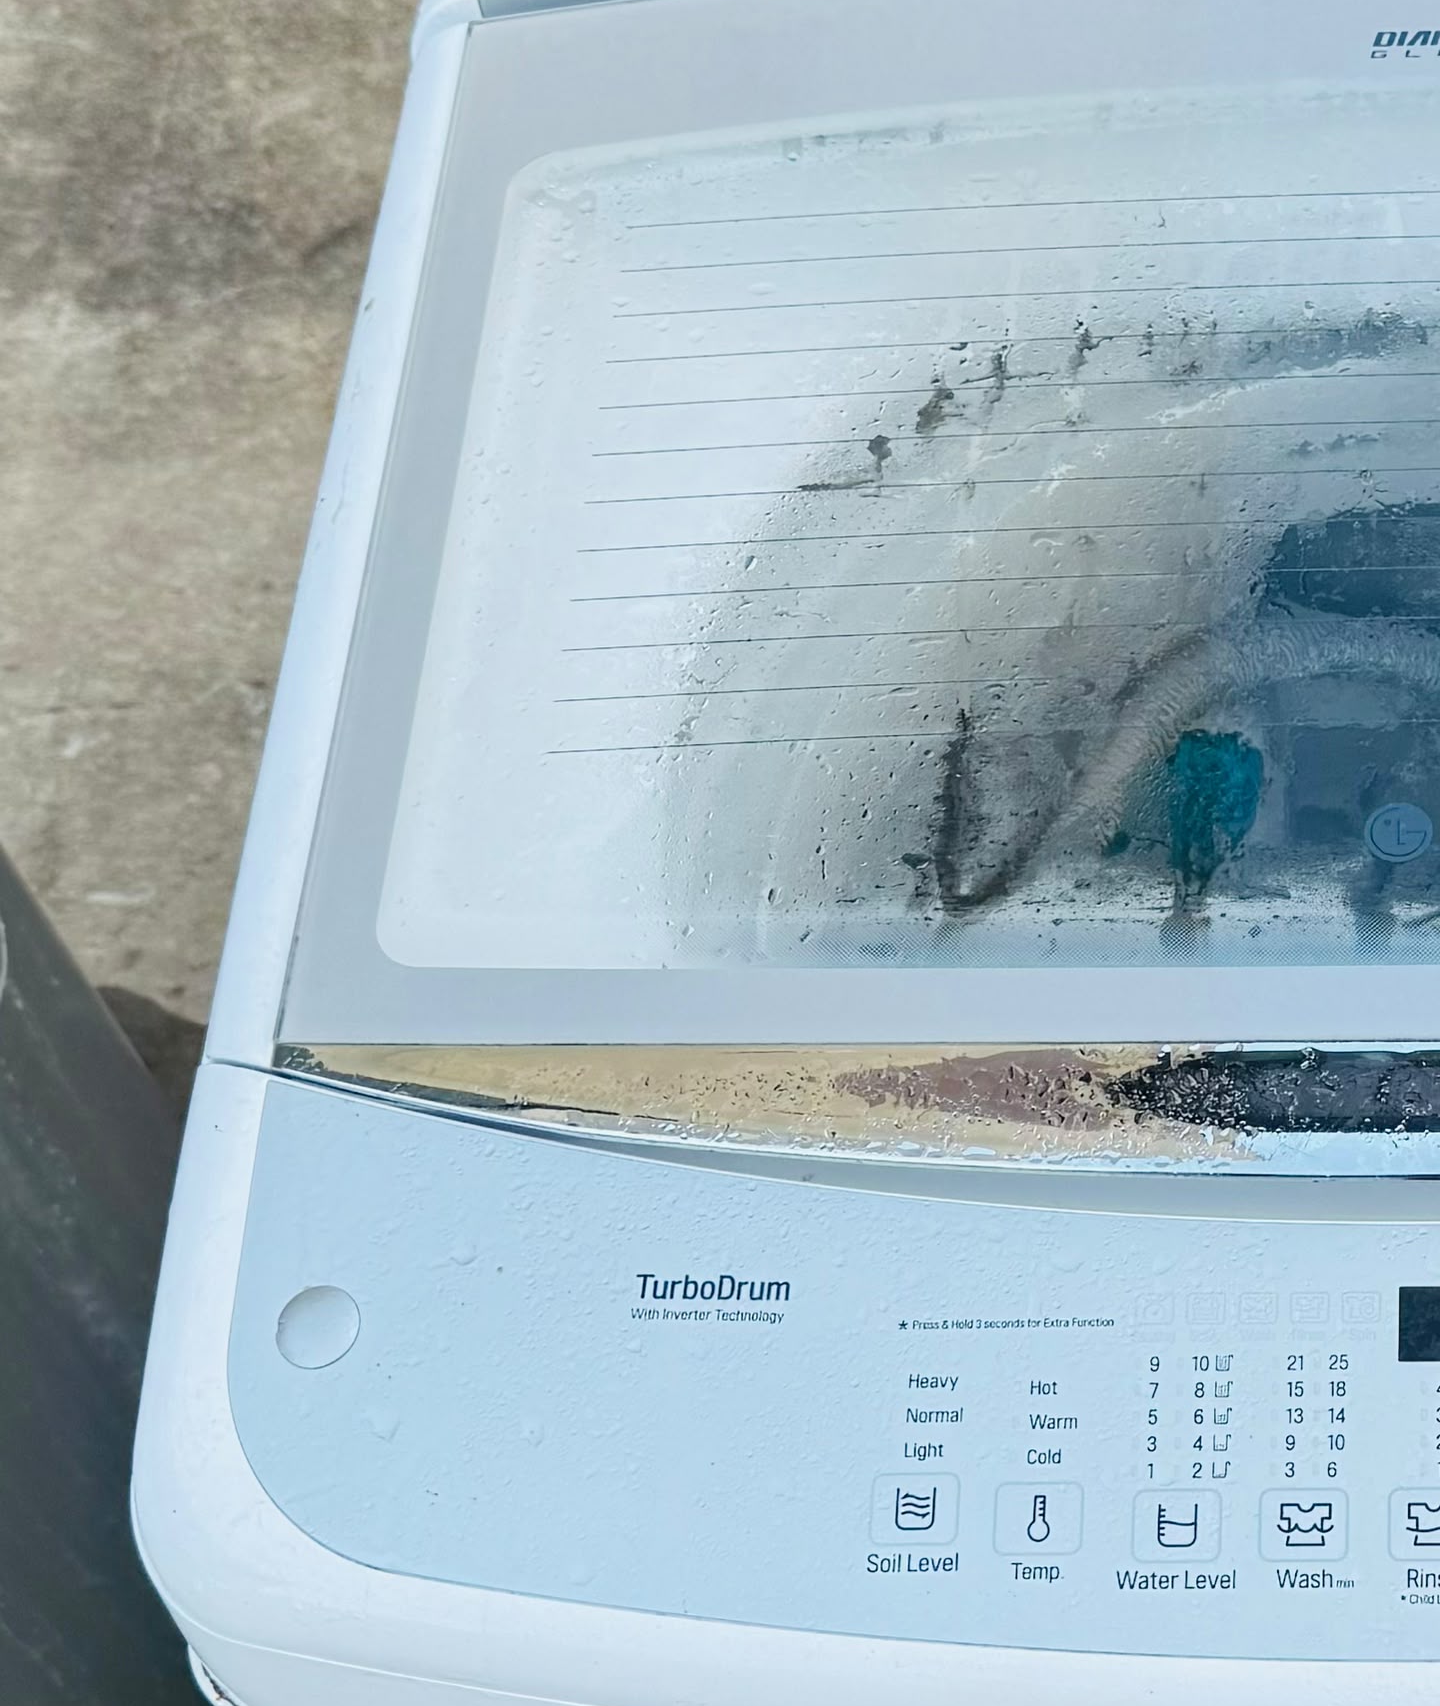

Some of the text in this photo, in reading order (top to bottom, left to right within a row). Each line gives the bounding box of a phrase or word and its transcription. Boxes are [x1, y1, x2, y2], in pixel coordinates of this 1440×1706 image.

[636, 1274, 791, 1301] TurboDrum
[631, 1308, 785, 1324] With Inverter Technology
[912, 1317, 1114, 1330] Press & Hold 3 seconds for Extra Function
[1150, 1355, 1210, 1372] 9 10
[1287, 1354, 1349, 1371] 21 25
[908, 1374, 959, 1391] Heavy
[1030, 1380, 1058, 1395] Hot
[1149, 1382, 1205, 1399] 7 8
[1287, 1381, 1347, 1397] 15 18
[906, 1407, 964, 1424] Normal
[1029, 1414, 1079, 1430] Warm
[1148, 1408, 1204, 1425] 5 6
[1286, 1407, 1346, 1424] 13 14
[1147, 1435, 1203, 1452] 3 4
[1285, 1434, 1345, 1451] 9 10
[904, 1442, 944, 1461] Light
[1027, 1449, 1062, 1465] Cold
[1147, 1462, 1203, 1479] 1 2
[1285, 1461, 1337, 1478] 3 6
[867, 1553, 959, 1573] Soil Level
[1011, 1562, 1065, 1584] Temp.
[1116, 1569, 1237, 1590] Water Level
[1277, 1569, 1355, 1589] Wash min
[1409, 1594, 1434, 1605] Child
